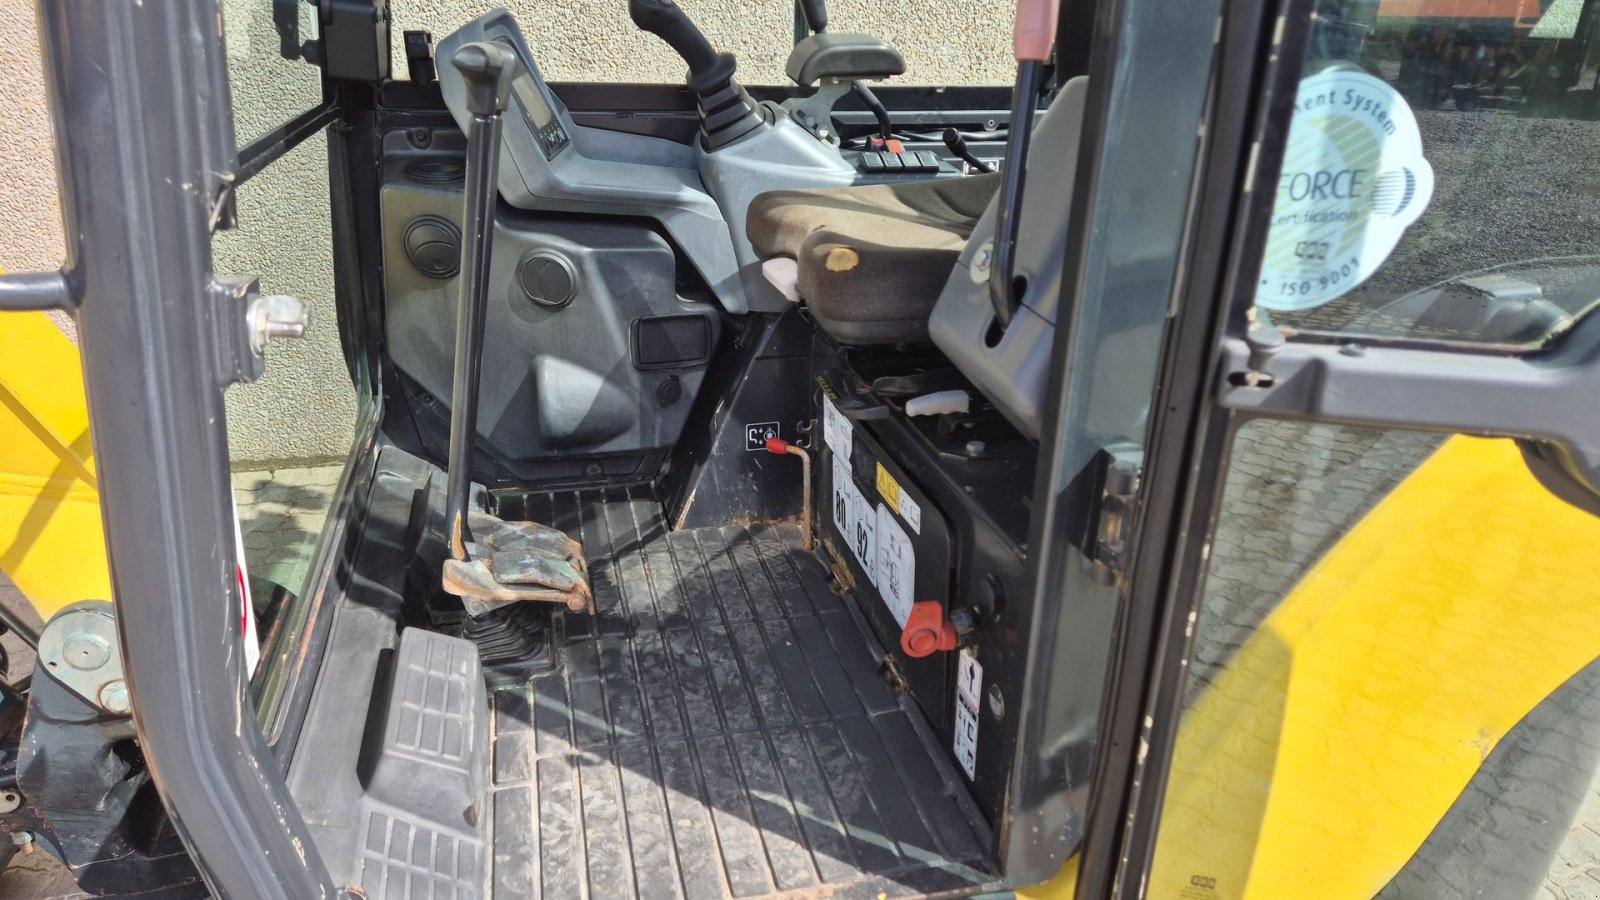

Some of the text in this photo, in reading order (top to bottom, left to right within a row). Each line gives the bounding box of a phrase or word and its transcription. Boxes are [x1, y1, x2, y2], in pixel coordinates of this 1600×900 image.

[1296, 87, 1397, 136] ent System
[1280, 280, 1311, 295] ISO
[1319, 256, 1360, 290] 9001
[836, 489, 847, 532] 80
[857, 520, 869, 568] 92
